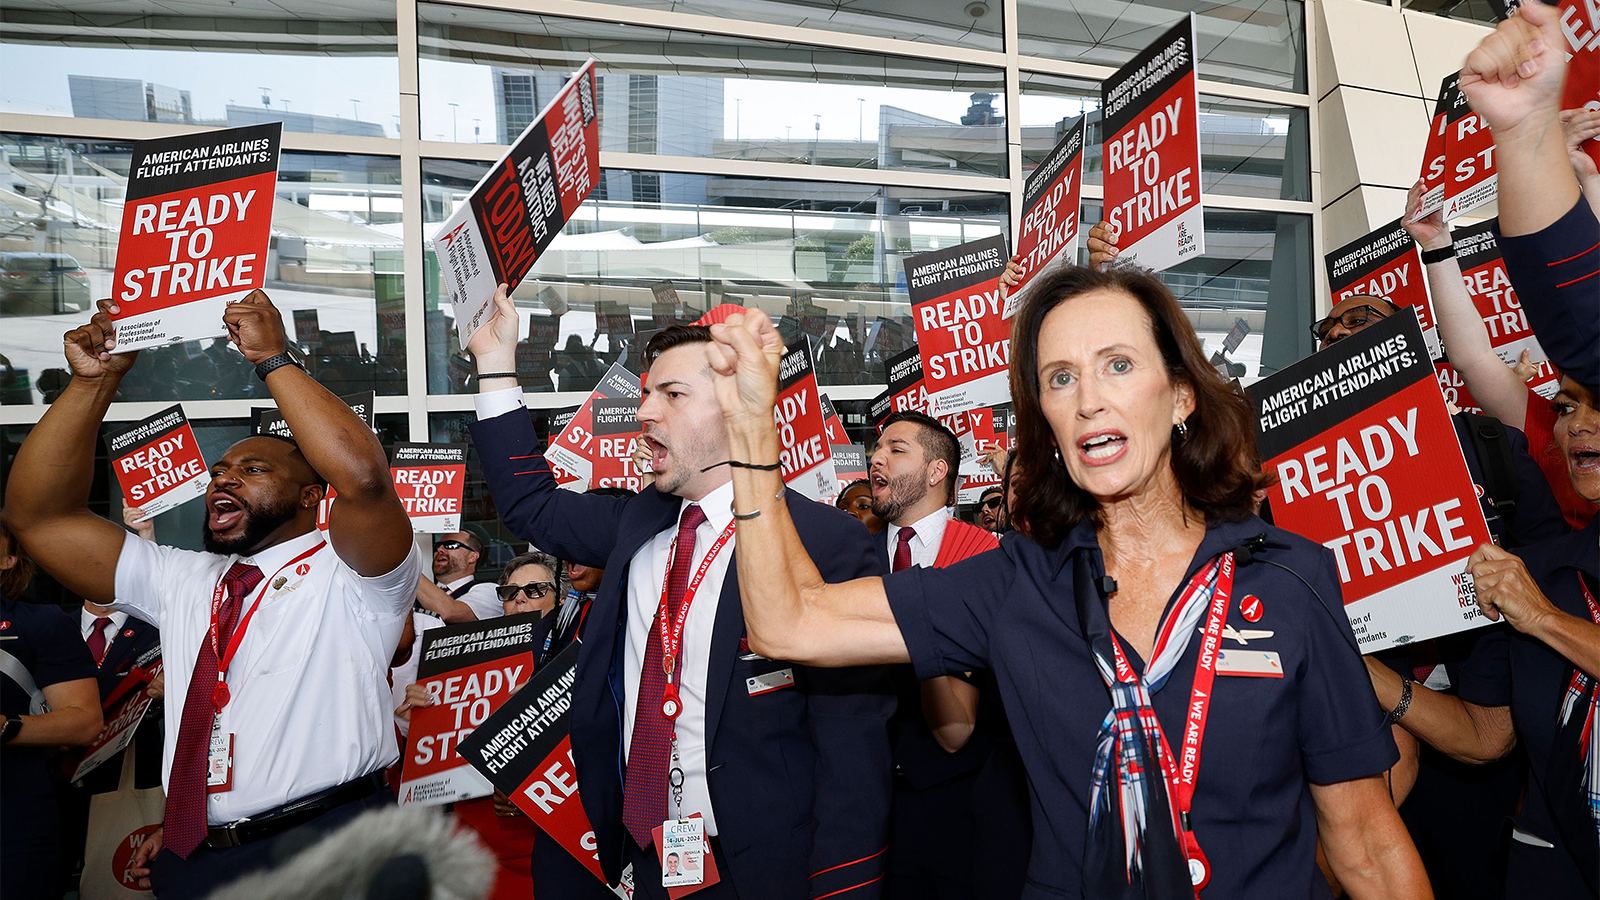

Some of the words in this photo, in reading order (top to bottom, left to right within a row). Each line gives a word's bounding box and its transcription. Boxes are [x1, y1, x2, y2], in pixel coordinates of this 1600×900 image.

[1105, 92, 1131, 119] FLIGHT
[1131, 52, 1190, 100] ATTENDANTS:
[1107, 65, 1146, 105] AMERICAN
[1145, 37, 1186, 81] AIRLINES
[1109, 97, 1183, 175] READY
[137, 162, 182, 179] FLIGHT
[183, 152, 271, 172] ATTENDANTS:
[142, 146, 209, 166] AMERICAN
[211, 138, 269, 156] AIRLINES
[517, 155, 532, 176] A
[550, 123, 575, 197] DELAY?
[1027, 158, 1056, 192] AMERICAN
[1055, 130, 1080, 163] AIRLINES
[535, 152, 550, 184] WE
[573, 162, 590, 201] THE
[1129, 150, 1160, 195] TO
[539, 180, 557, 218] NEED
[1023, 168, 1075, 238] READY
[1025, 179, 1043, 202] FLIGHT
[1109, 167, 1192, 239] STRIKE
[1459, 184, 1491, 201] Association
[1459, 188, 1494, 205] Professional
[1459, 200, 1475, 210] Flight
[132, 190, 256, 236] READY
[485, 157, 537, 288] TODAY!
[521, 172, 548, 244] CONTRACT
[1037, 210, 1057, 243] TO
[1177, 222, 1184, 231] WE
[1178, 229, 1187, 238] ARE
[1178, 235, 1193, 247] READY
[165, 227, 214, 263] TO
[1020, 211, 1075, 281] STRIKE
[1178, 244, 1196, 256] apfa.org
[1332, 260, 1357, 278] FLIGHT
[1358, 235, 1411, 267] ATTENDANTS:
[1333, 243, 1371, 269] AMERICAN
[1372, 227, 1407, 254] AIRLINES
[121, 254, 257, 302] STRIKE
[911, 272, 942, 288] FLIGHT
[943, 258, 1003, 281] ATTENDANTS:
[912, 258, 958, 278] AMERICAN
[959, 248, 999, 266] AIRLINES
[920, 289, 999, 331] READY
[118, 328, 154, 338] Professional
[118, 336, 133, 345] Flight
[134, 333, 166, 342] Attendants
[120, 321, 154, 331] Association
[948, 321, 983, 350] TO
[890, 367, 910, 383] FLIGHT
[891, 354, 921, 375] AMERICAN
[1261, 370, 1333, 414] AMERICAN
[1337, 334, 1408, 384] AIRLINES
[606, 377, 629, 395] FLIGHT
[1259, 398, 1309, 432] FLIGHT
[1312, 351, 1418, 412] ATTENDANTS:
[597, 415, 622, 423] FLIGHT
[599, 406, 638, 414] AMERICAN
[111, 437, 136, 451] FLIGHT
[137, 416, 184, 440] ATTENDANTS:
[112, 424, 148, 444] AMERICAN
[149, 411, 180, 428] AIRLINES
[777, 423, 796, 449] O
[120, 434, 184, 474] READY
[144, 457, 173, 478] TO
[833, 452, 860, 460] AIRLINES
[1276, 407, 1420, 505] READY
[130, 459, 202, 500] STRIKE
[395, 470, 456, 484] READY
[412, 484, 437, 498] TO
[400, 498, 457, 513] TRIKE
[1325, 474, 1393, 532] TO
[1322, 497, 1474, 584] TRIKE
[693, 574, 701, 586] WE
[700, 561, 709, 575] ARE
[706, 542, 722, 561] READY
[1451, 572, 1468, 586] WE
[1457, 583, 1475, 596] ARE
[1212, 599, 1225, 615] WE
[1364, 612, 1371, 622] of
[429, 631, 484, 649] AMERICAN
[485, 622, 532, 640] AIRLINES
[672, 637, 678, 650] WE
[677, 601, 689, 624] READY
[1208, 615, 1221, 636] ARE
[1358, 631, 1387, 645] endants
[425, 644, 461, 661] FLIGHT
[463, 633, 533, 655] ATTENDANTS:
[1201, 635, 1216, 670] READY
[427, 665, 523, 705] READY
[450, 698, 490, 729] TO
[479, 705, 540, 762] AMERICAN
[538, 664, 578, 714] AIRLINE
[1191, 701, 1208, 721] WE
[1186, 720, 1202, 747] ARE
[486, 734, 529, 774] FLIGHT
[1182, 746, 1199, 785] READY
[667, 835, 700, 843] 14-JUL-2024
[671, 824, 697, 833] CREW
